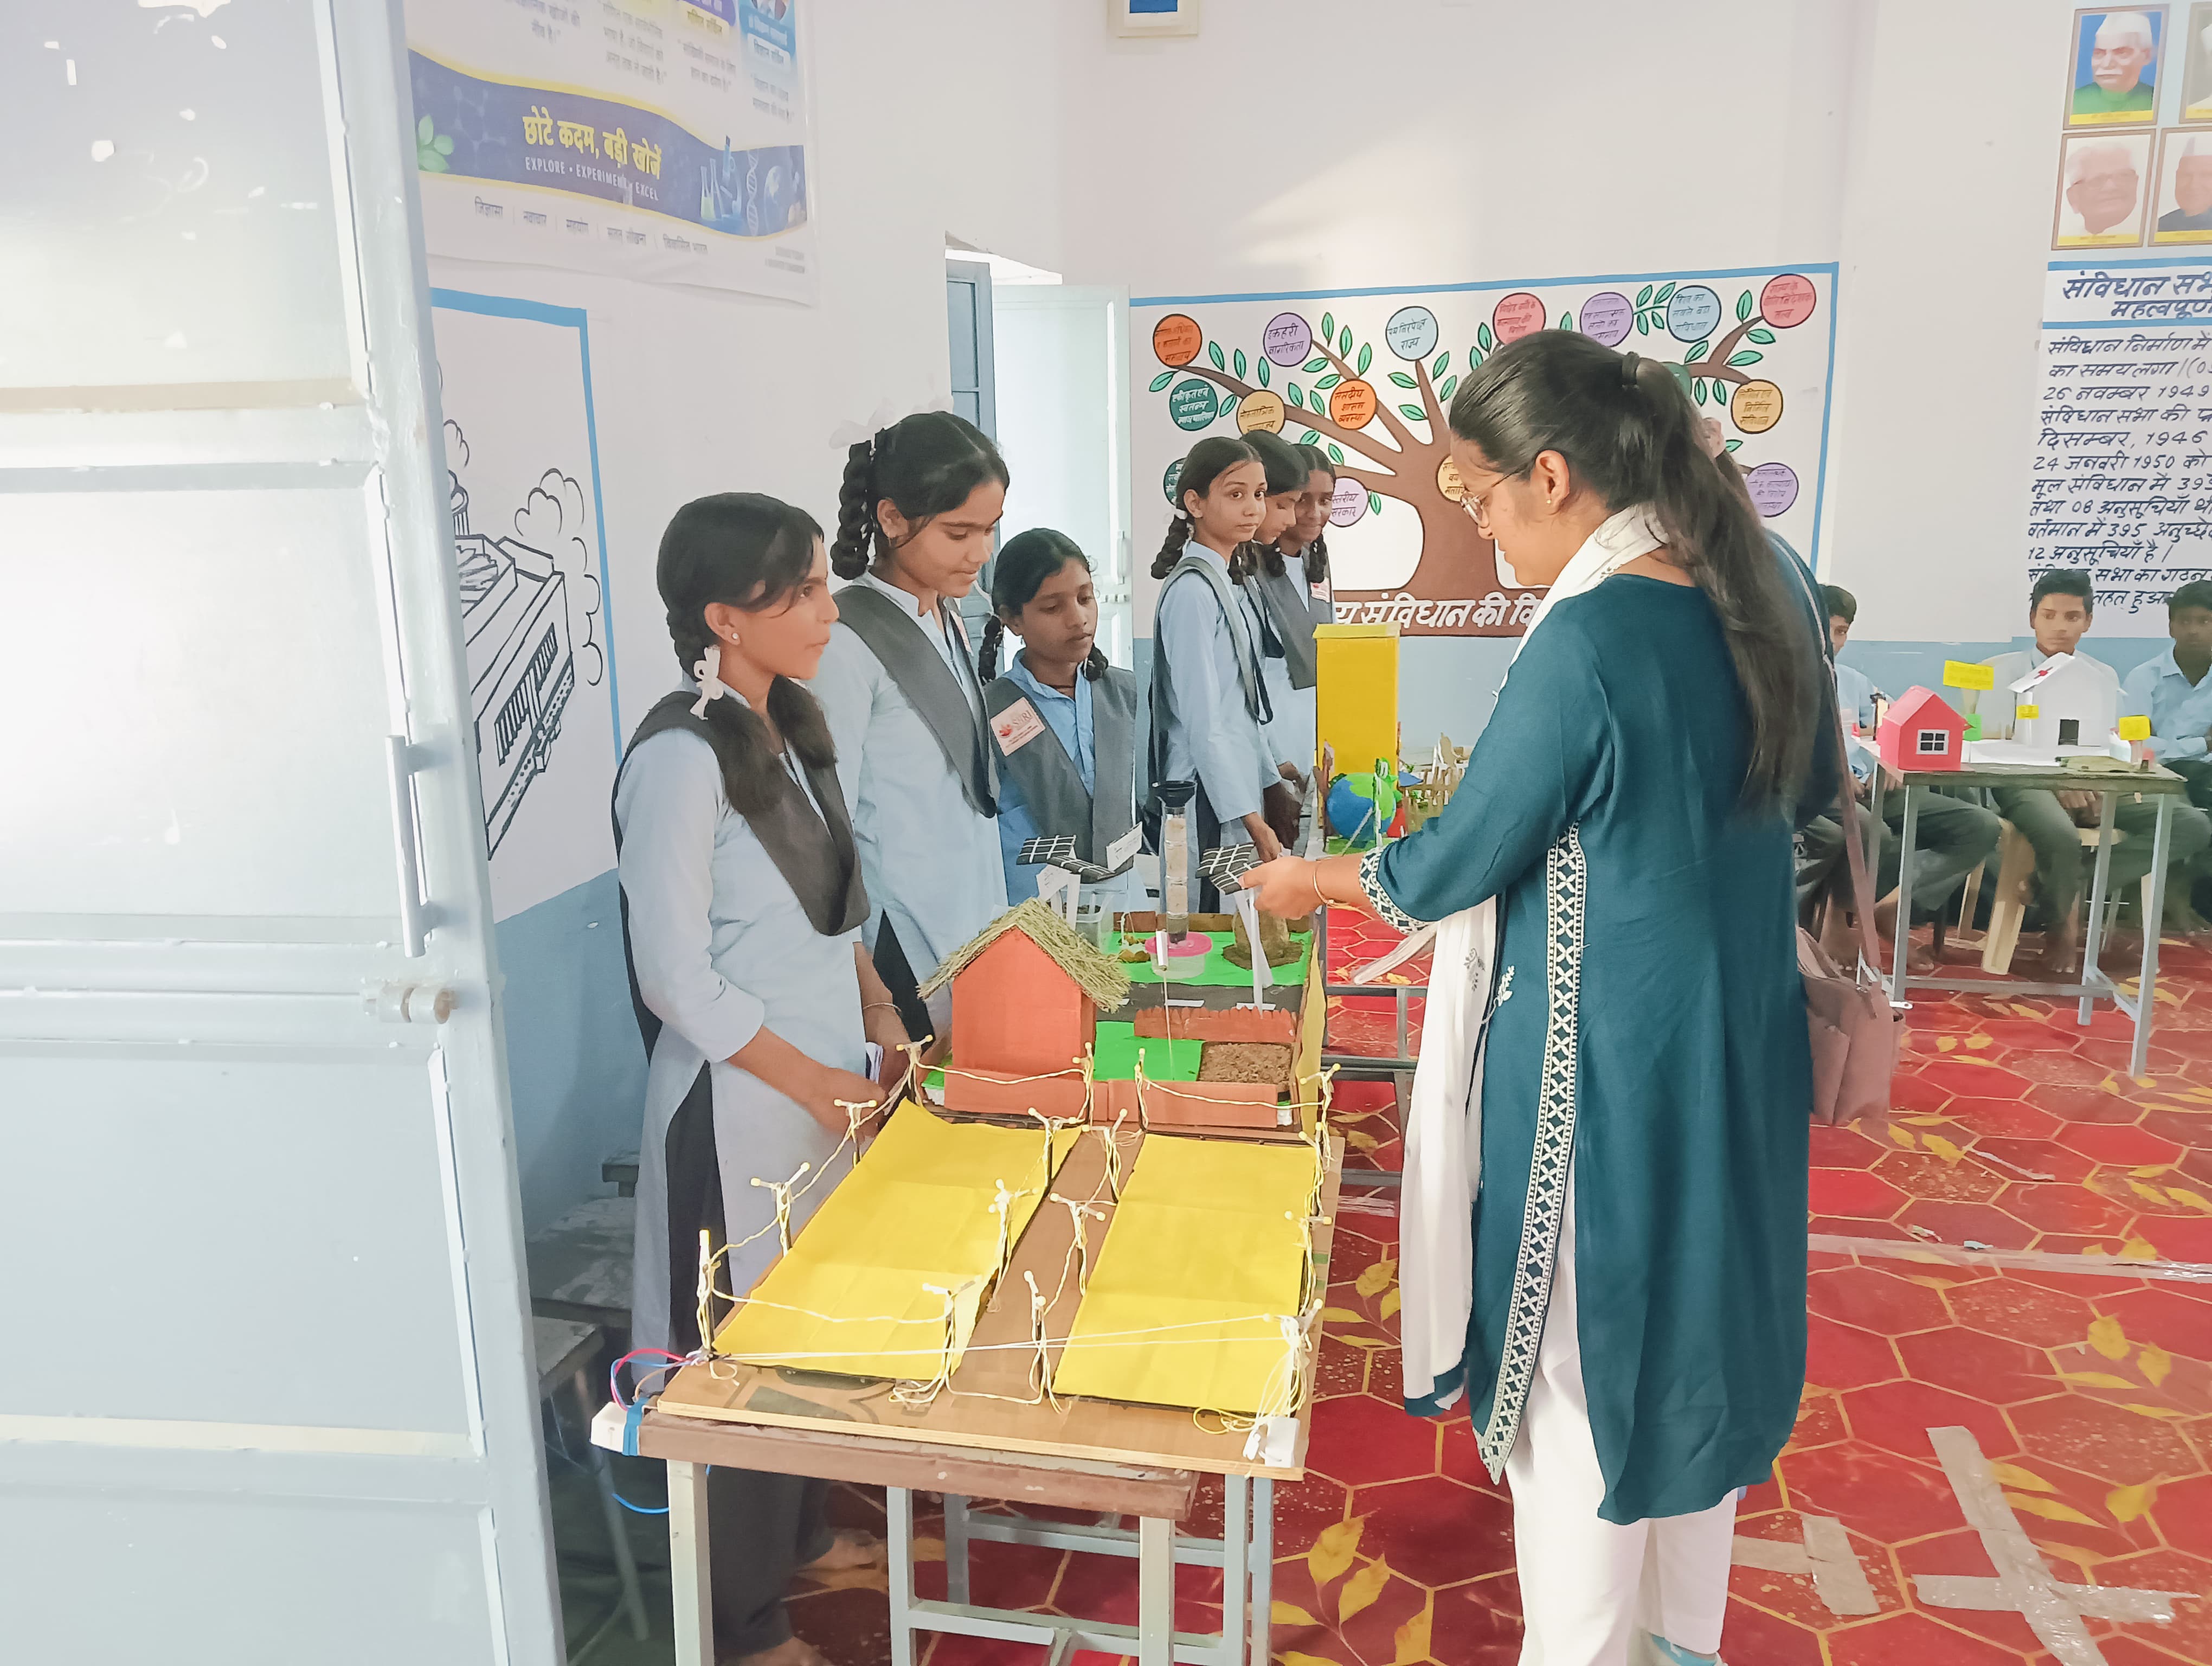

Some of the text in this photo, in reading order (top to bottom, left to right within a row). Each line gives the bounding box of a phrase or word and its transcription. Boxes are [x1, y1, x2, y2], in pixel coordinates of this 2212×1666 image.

[522, 105, 554, 146] छोटे
[557, 120, 600, 159] कदम,
[602, 127, 628, 169] बड़ी
[525, 157, 565, 175] EXPLORE
[635, 182, 659, 201] EXCEL
[2063, 271, 2212, 299] संविधान सभ
[1268, 322, 1299, 339] इकहरी
[1401, 336, 1420, 350] राज्य
[2048, 330, 2212, 355] संविधान निर्माण में
[2049, 364, 2079, 377] का
[2080, 363, 2137, 378] समय
[2043, 385, 2210, 402] 26 नवम्बर 1949
[2041, 405, 2118, 425] संविधान
[2117, 407, 2159, 424] सभा
[2160, 403, 2191, 421] की
[2146, 430, 2208, 446] 1946
[2034, 448, 2212, 471] 24 जनवरी 1950 को
[1332, 490, 1359, 504] स्तरीय
[2031, 479, 2067, 500] मूल
[2068, 473, 2148, 495] संविधान
[2149, 471, 2172, 491] में
[2029, 499, 2067, 517] तथा
[2072, 499, 2094, 514] 08
[2097, 493, 2190, 520] अनुसूचियाँ
[2028, 518, 2088, 539] वर्तमान
[2085, 516, 2107, 538] में
[2107, 522, 2148, 538] 395
[2028, 547, 2046, 560] 12
[2049, 539, 2145, 566] अनुसूचियाँ
[2095, 567, 2135, 582] सभा
[2134, 569, 2162, 582] का
[1361, 592, 1476, 628] संविधान
[1472, 592, 1512, 627] की
